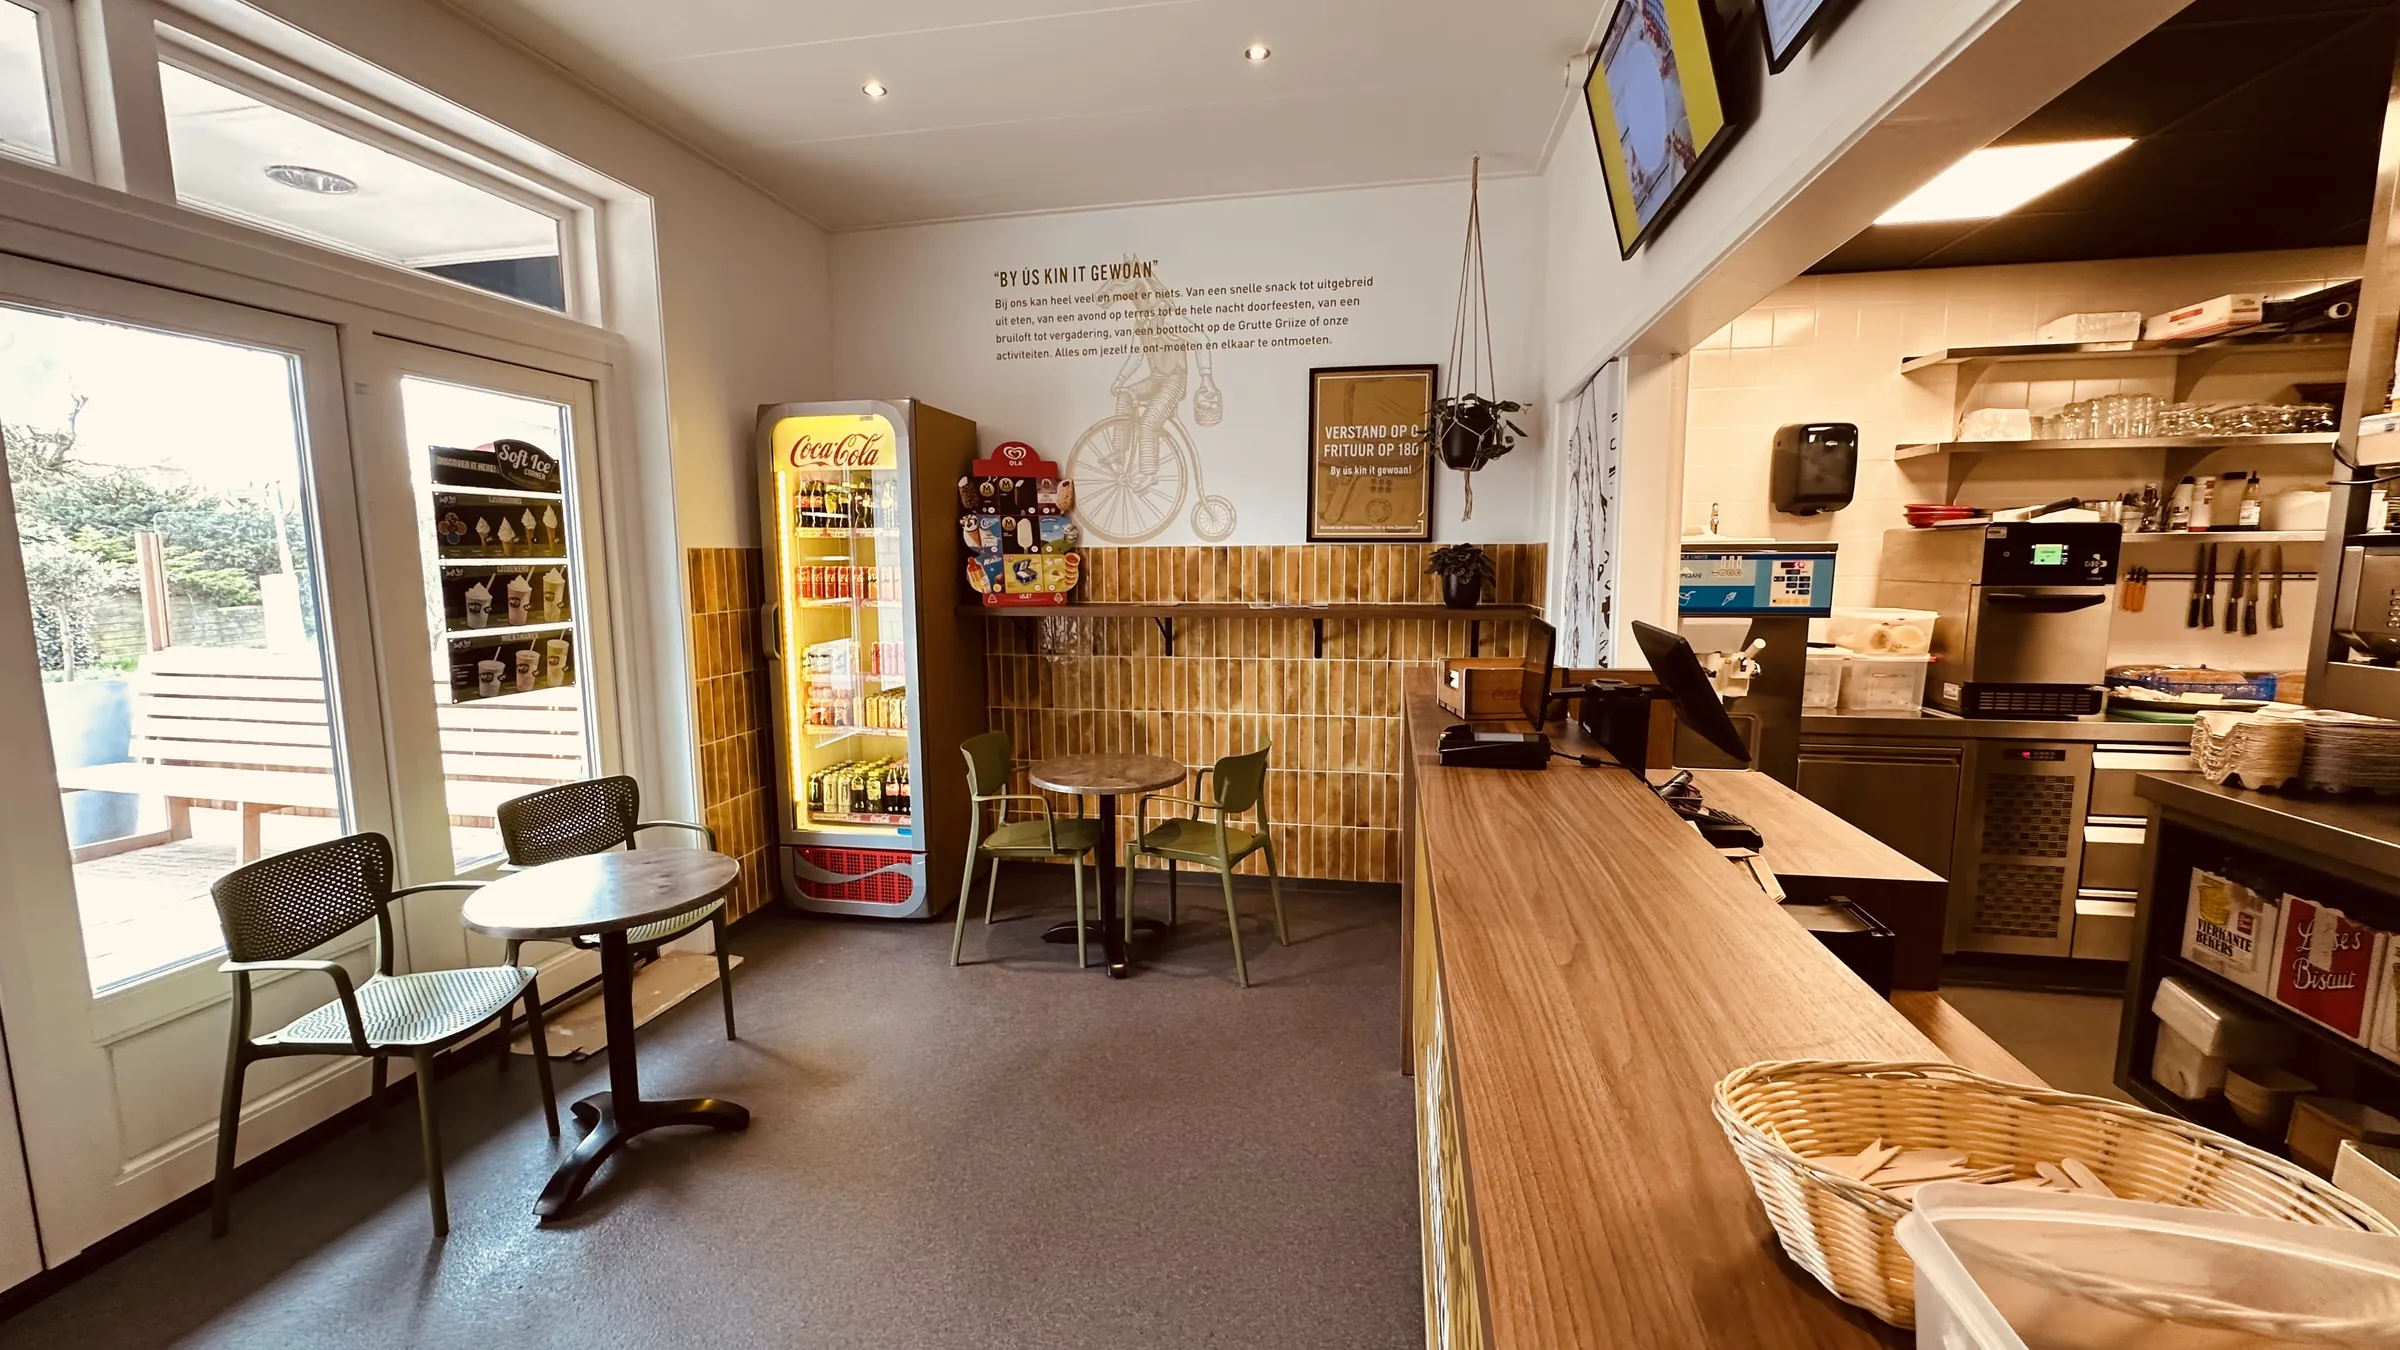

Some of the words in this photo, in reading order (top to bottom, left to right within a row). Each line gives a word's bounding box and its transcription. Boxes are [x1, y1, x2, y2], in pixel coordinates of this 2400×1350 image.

[1022, 266, 1040, 286] ÚS
[1044, 267, 1068, 284] KIN
[1073, 266, 1086, 282] IT
[995, 298, 1008, 311] Bij
[1010, 299, 1028, 308] ons
[1030, 297, 1048, 307] kan
[1050, 294, 1072, 305] heel
[1074, 293, 1095, 303] veel
[1097, 294, 1110, 303] en
[1112, 291, 1138, 301] moet
[1141, 292, 1152, 300] er
[1155, 289, 1183, 298] niets.
[1186, 287, 1205, 297] Van
[1207, 287, 1227, 296] een
[1229, 283, 1262, 295] snelle
[1265, 281, 1297, 293] snack
[1300, 280, 1314, 290] tot
[1317, 276, 1374, 291] uitgebreid
[995, 316, 1008, 326] uit
[1010, 316, 1035, 326] eten,
[1037, 315, 1054, 324] van
[1056, 314, 1075, 323] een
[1077, 310, 1106, 321] avond
[1109, 311, 1122, 322] op
[1124, 309, 1155, 319] terras
[1158, 307, 1172, 317] tot
[1175, 306, 1187, 316] de
[1190, 304, 1213, 315] hele
[1215, 302, 1245, 314] nacht
[1247, 299, 1315, 312] doorfeesten,
[1318, 299, 1337, 308] van
[1339, 297, 1360, 307] een
[996, 332, 1032, 344] bruiloft
[1034, 332, 1047, 341] tot
[1049, 328, 1112, 342] vergadering,
[1114, 328, 1132, 337] van
[1134, 327, 1153, 336] een
[1156, 323, 1204, 335] boottocht
[1207, 324, 1220, 334] op
[1222, 321, 1235, 331] de
[1238, 320, 1272, 330] Grutte
[1275, 317, 1307, 329] Griize
[1309, 316, 1320, 327] of
[1323, 317, 1349, 326] onze
[996, 348, 1052, 361] activiteiten.
[1055, 347, 1079, 358] Alles
[1082, 347, 1097, 356] om
[1100, 344, 1128, 358] jezelf
[1130, 344, 1140, 353] te
[1143, 341, 1203, 353] ont-moeten
[1205, 342, 1218, 350] en
[1221, 339, 1255, 349] elkaar
[1258, 338, 1268, 348] te
[1271, 335, 1332, 347] ontmoeten.
[1325, 425, 1387, 440] VERSTAND
[1390, 424, 1407, 438] OP
[437, 456, 470, 469] DISCOVER
[470, 461, 477, 470] IT
[499, 444, 529, 469] Soft
[531, 454, 552, 474] Ice
[789, 432, 884, 468] Coca-Cola
[1324, 443, 1374, 457] FRITUUR
[1378, 443, 1394, 457] OP
[524, 467, 546, 480] CORNER
[1330, 465, 1341, 477] By
[1354, 465, 1367, 475] kin
[1369, 465, 1376, 475] it
[1377, 465, 1412, 477] gewoan!
[2196, 930, 2233, 957] BEKERS
[2198, 918, 2252, 952] VIERKANTE
[2292, 957, 2356, 990] Biscuit
